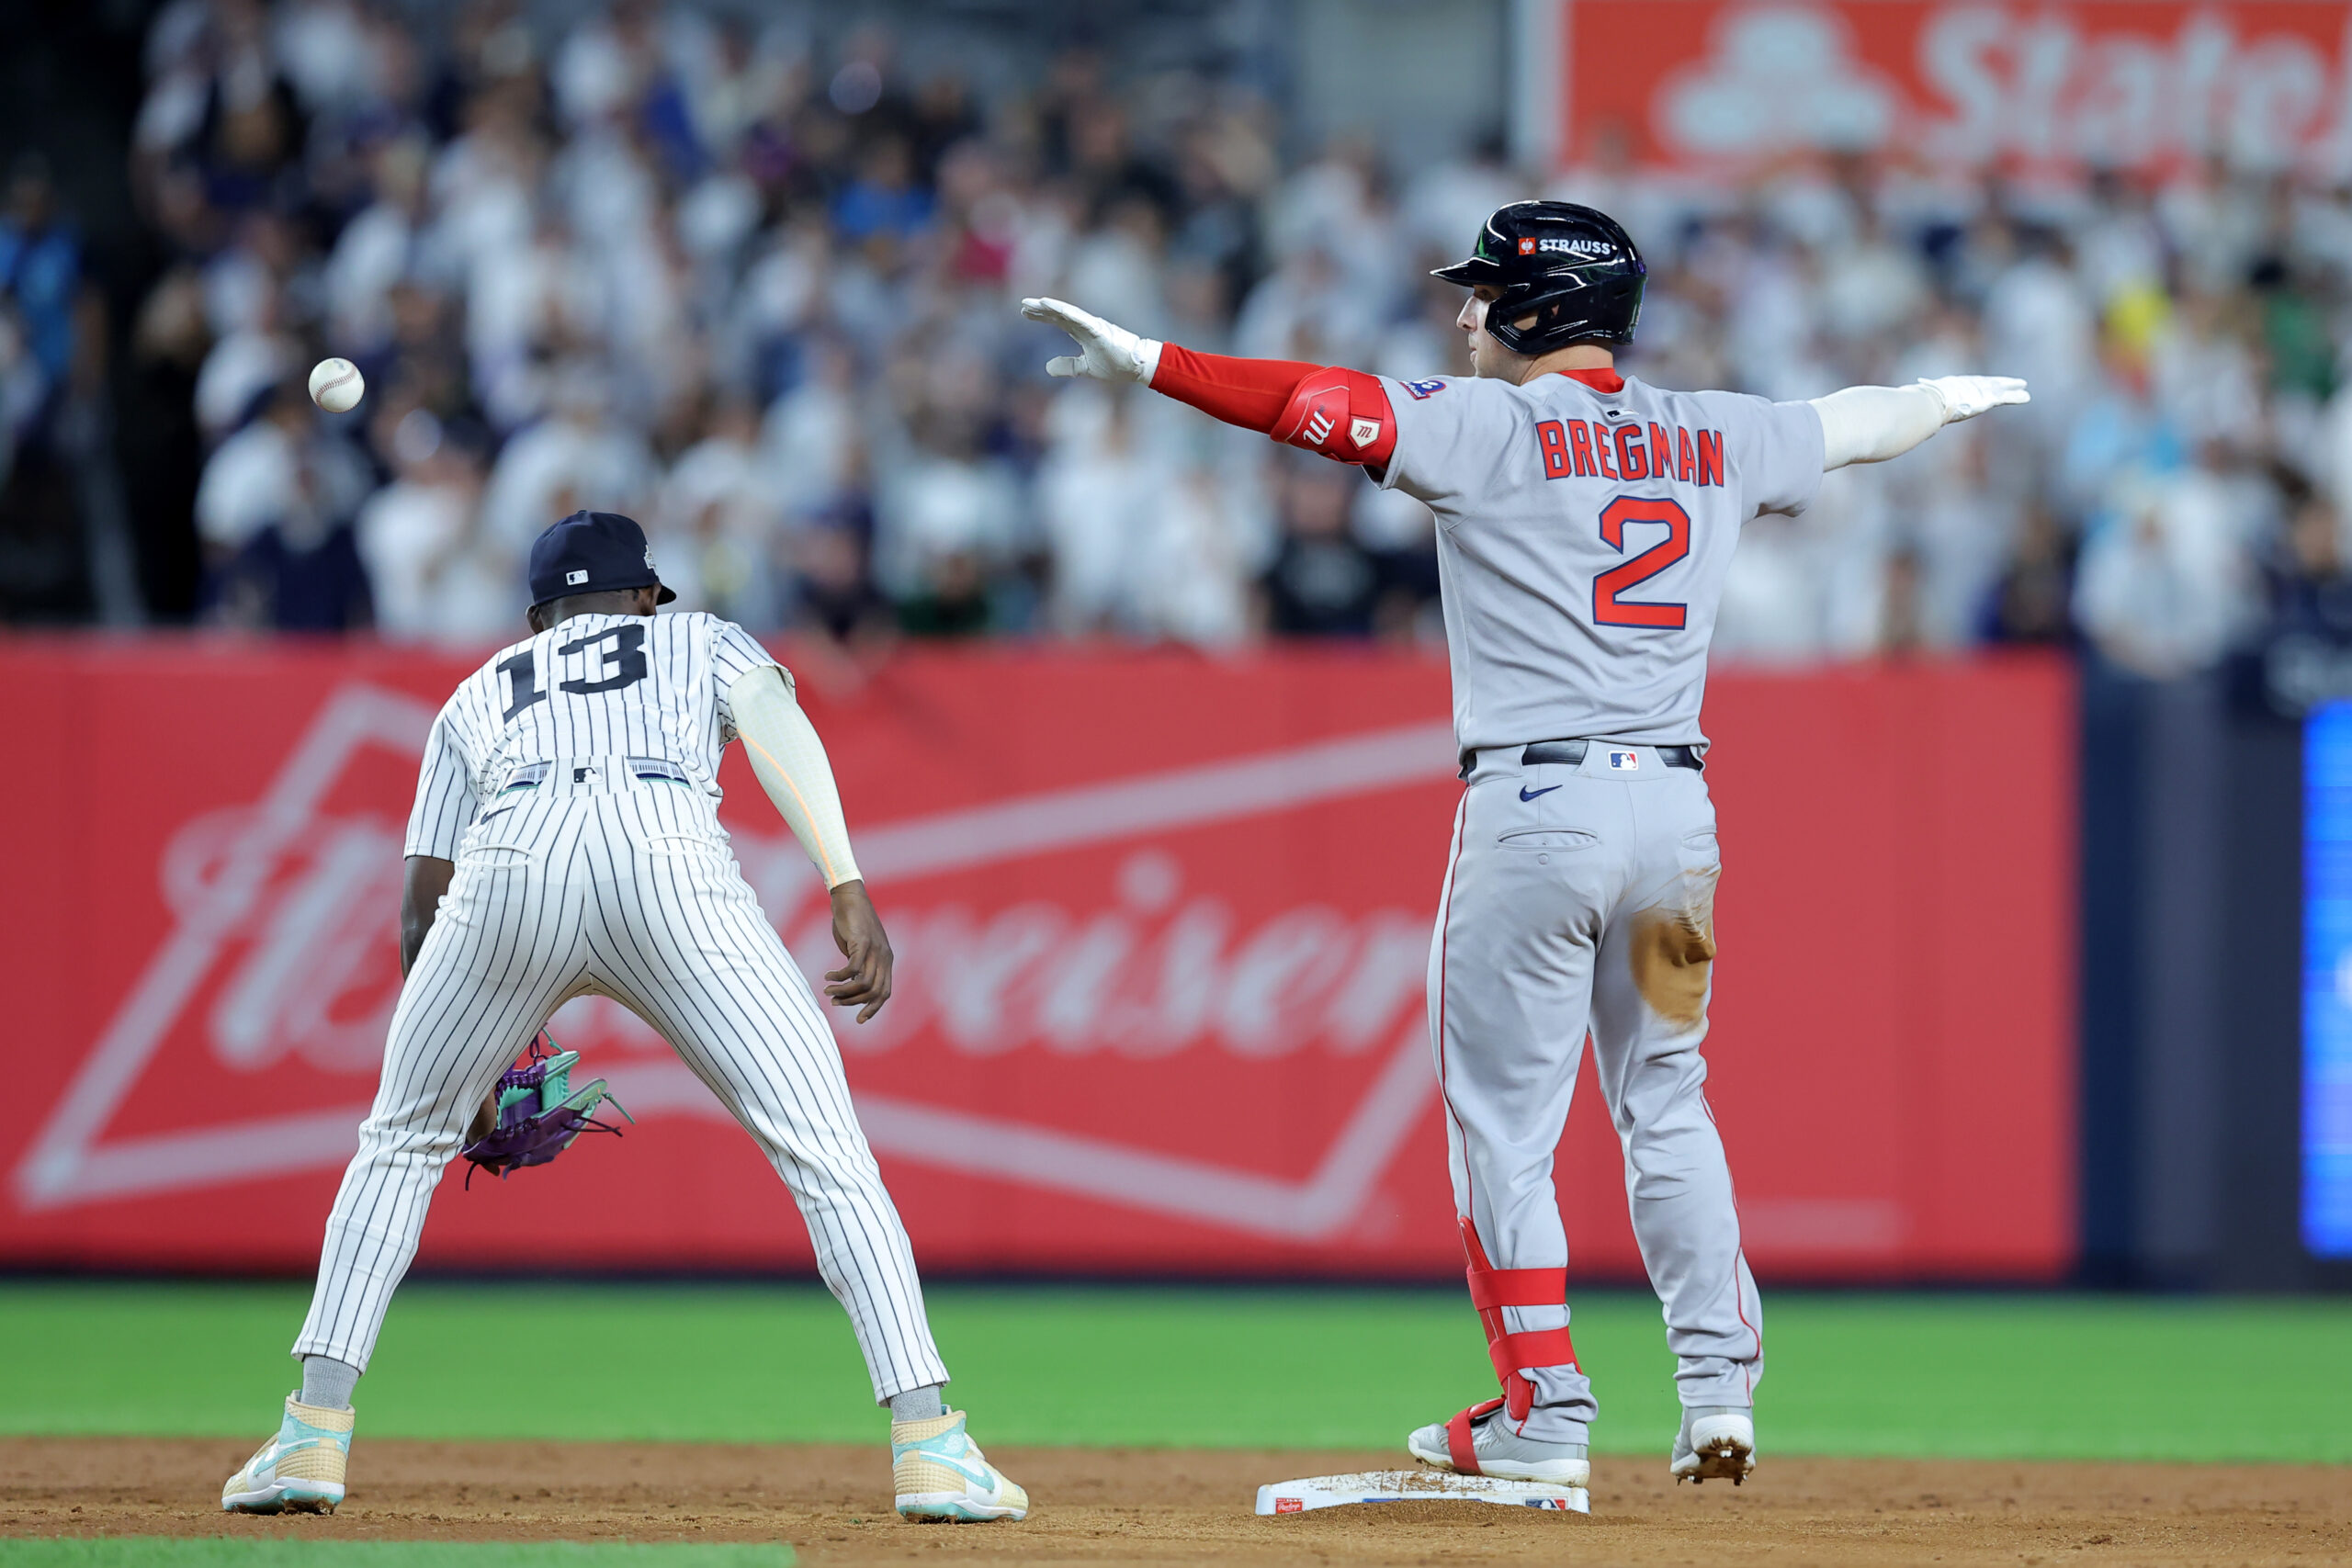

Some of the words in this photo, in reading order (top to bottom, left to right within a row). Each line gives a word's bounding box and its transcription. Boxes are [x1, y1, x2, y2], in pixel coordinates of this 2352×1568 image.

[1917, 4, 2327, 169] State
[1539, 239, 1611, 255] STRAUSS
[1535, 418, 1724, 488] BREGMAN
[1592, 494, 1691, 631] 2
[496, 623, 649, 725] 13
